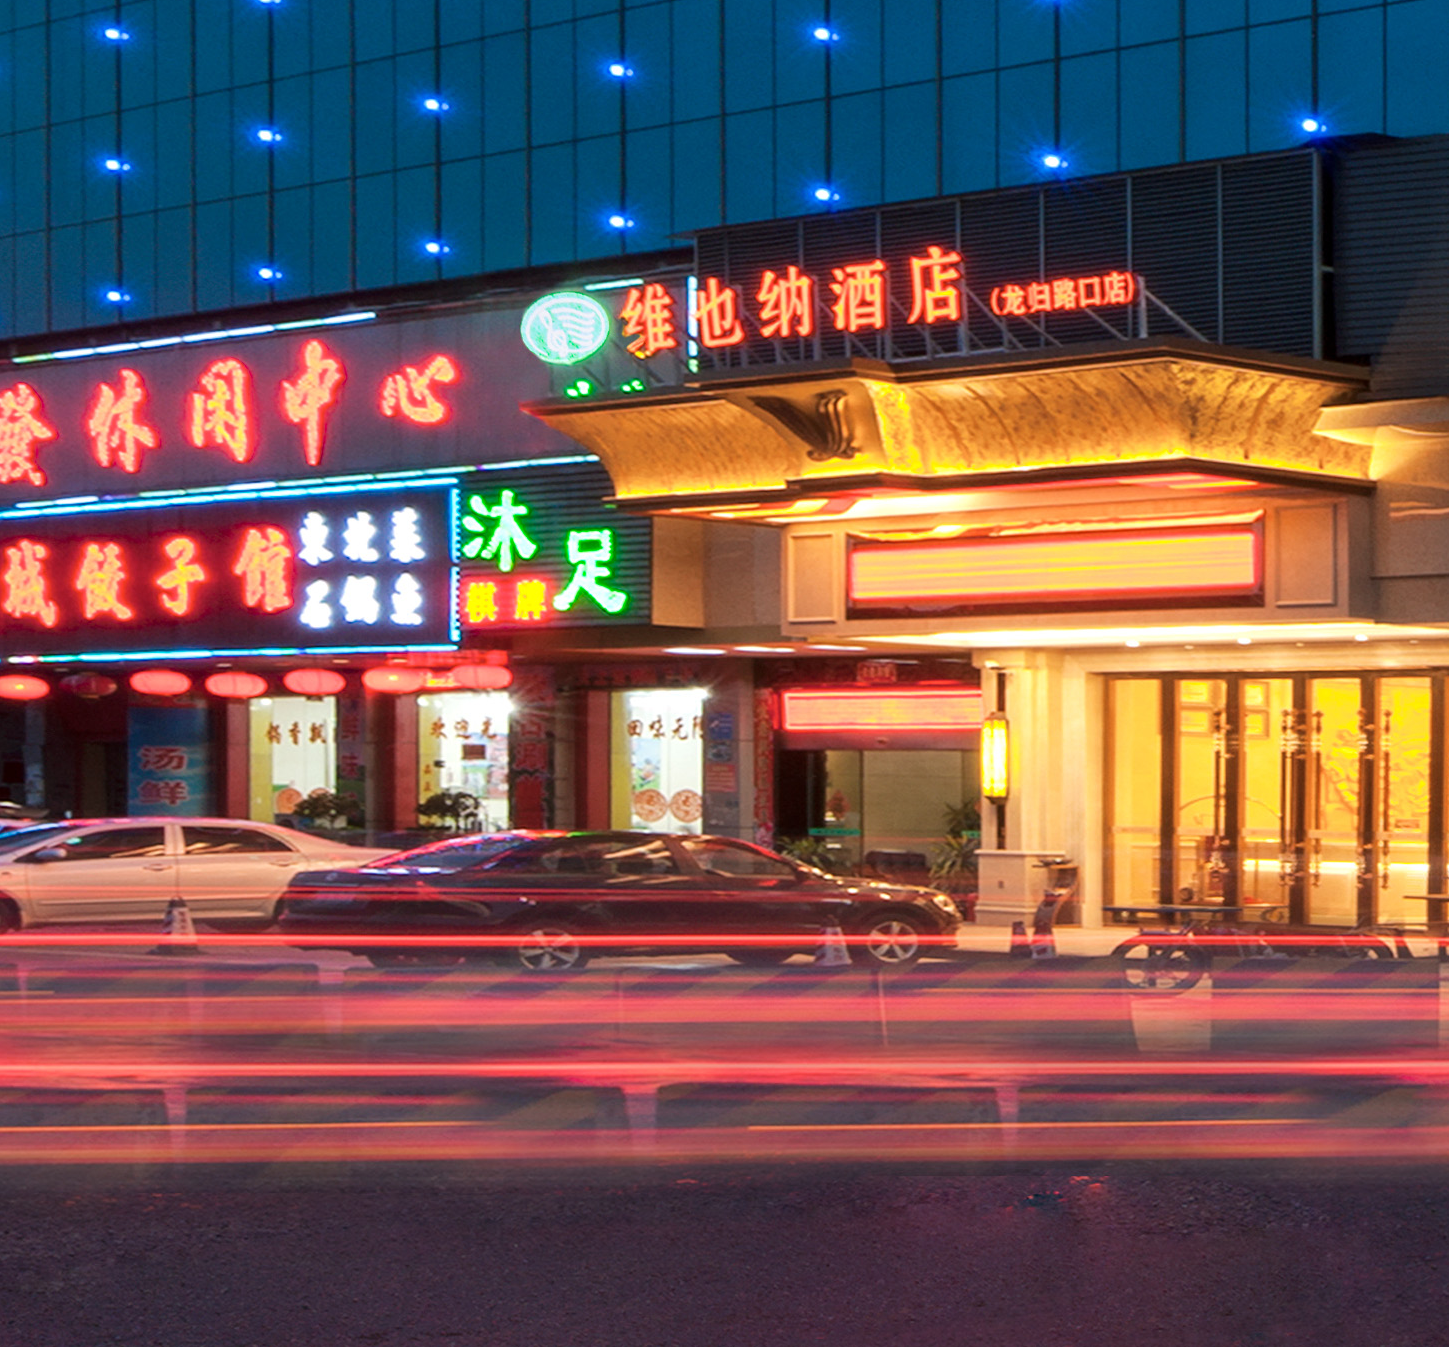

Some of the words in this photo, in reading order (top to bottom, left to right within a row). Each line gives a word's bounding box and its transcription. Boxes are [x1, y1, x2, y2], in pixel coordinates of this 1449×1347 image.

[621, 245, 962, 357] 维也纳酒店
[462, 489, 627, 614] 沐足
